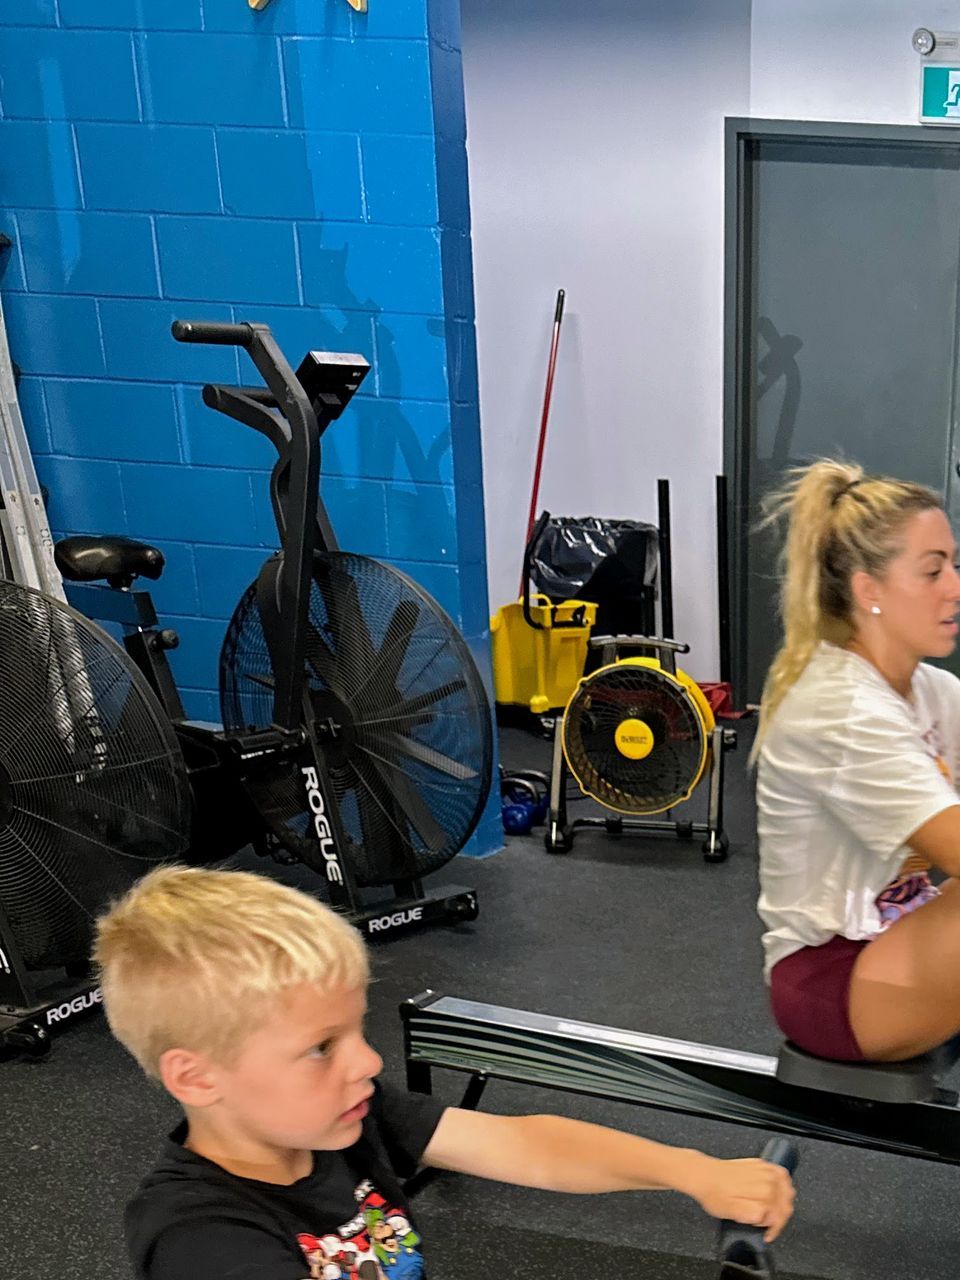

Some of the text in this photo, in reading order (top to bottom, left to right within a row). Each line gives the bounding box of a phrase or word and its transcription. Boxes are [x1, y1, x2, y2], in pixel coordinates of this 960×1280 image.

[302, 766, 342, 882] ROGUE
[368, 907, 424, 933] ROGUE
[46, 987, 103, 1025] ROGUE
